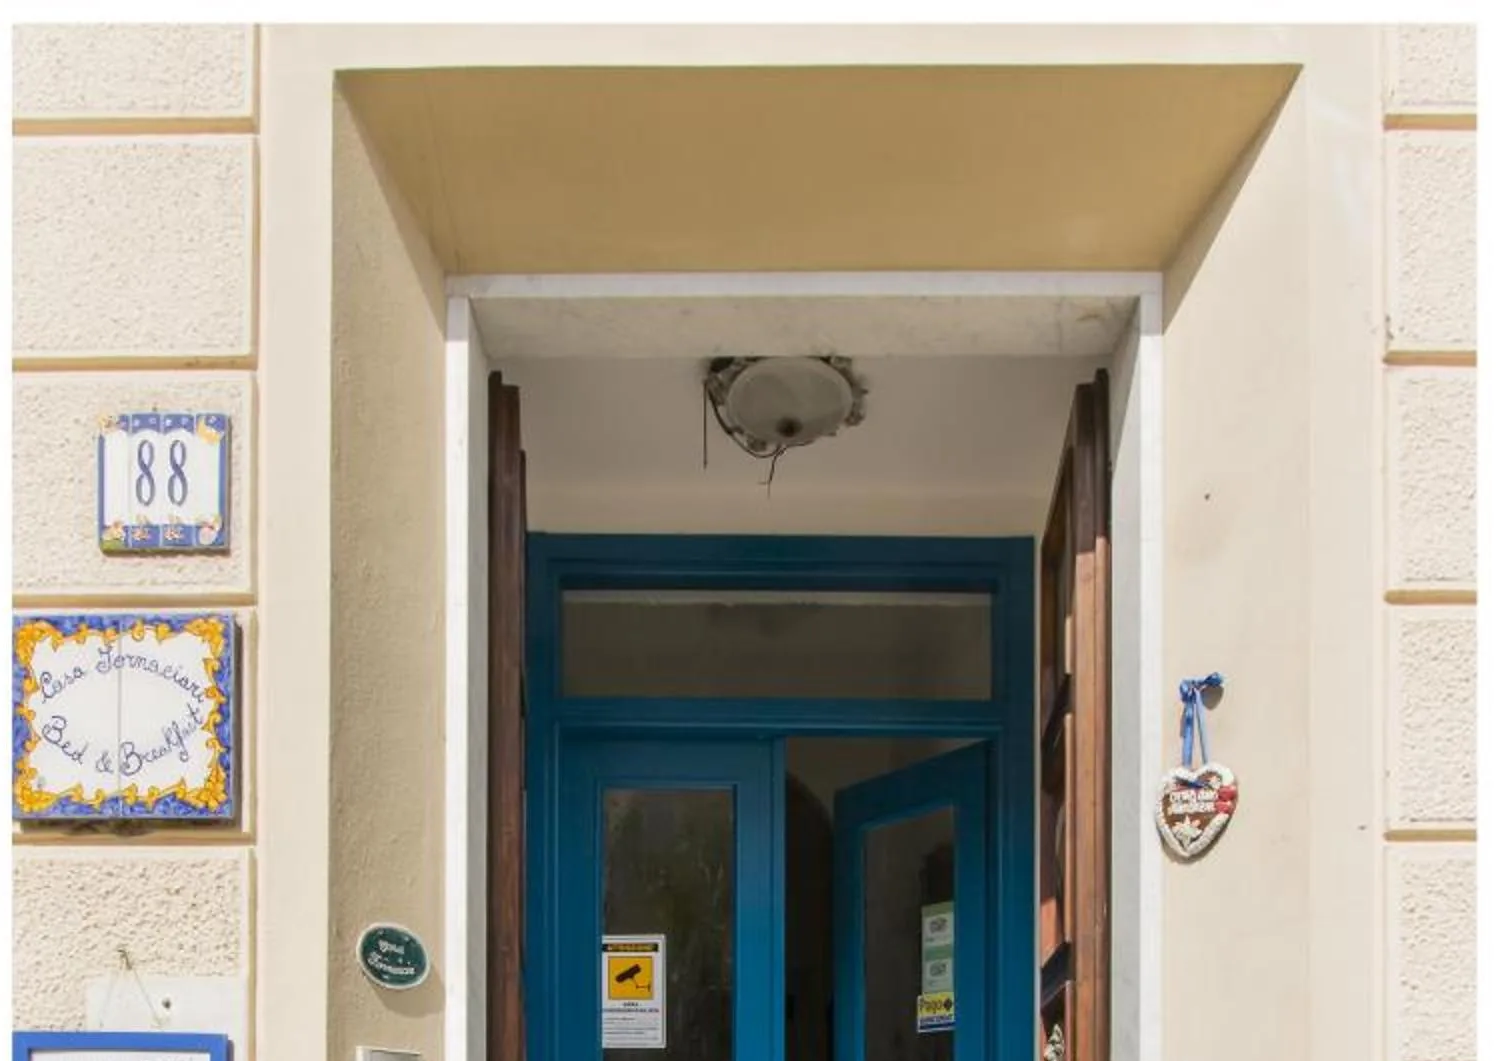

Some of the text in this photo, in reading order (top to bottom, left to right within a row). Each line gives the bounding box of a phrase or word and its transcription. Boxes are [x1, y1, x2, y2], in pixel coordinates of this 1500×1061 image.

[135, 439, 188, 507] 88
[40, 667, 86, 704] Casa
[41, 703, 203, 776] Bed & Breakfast
